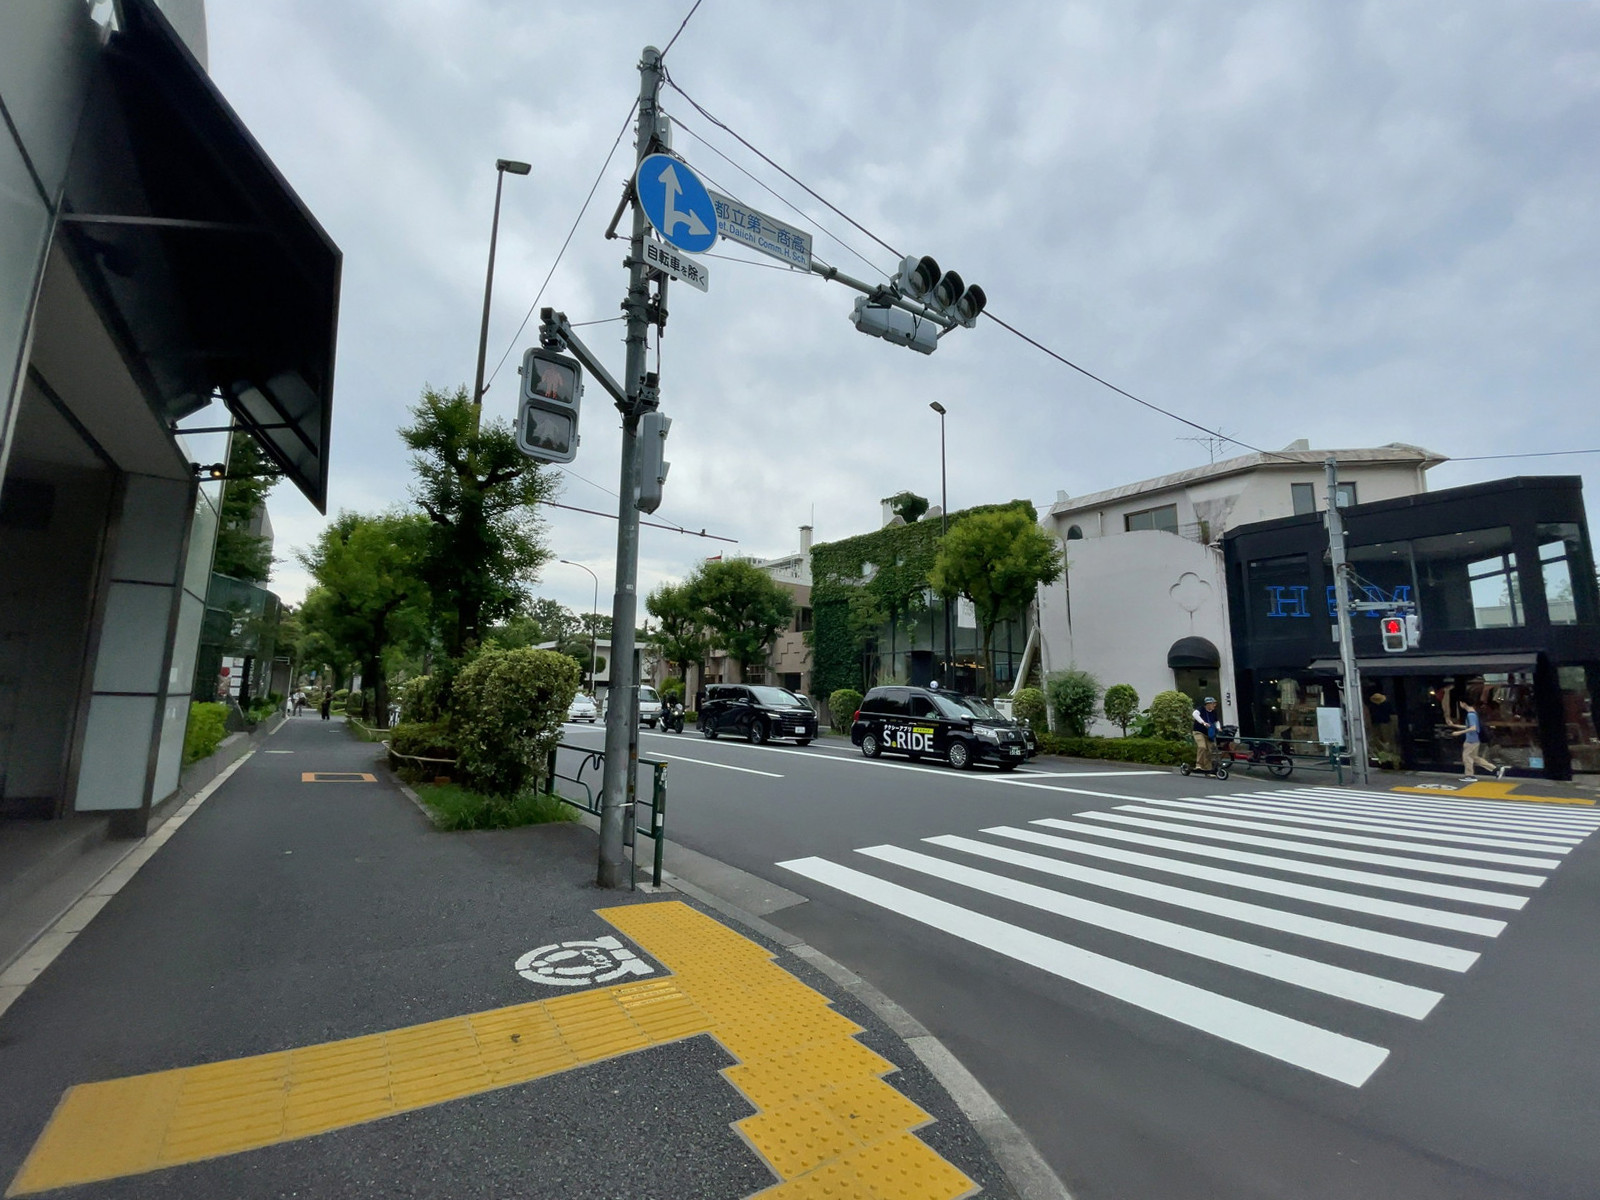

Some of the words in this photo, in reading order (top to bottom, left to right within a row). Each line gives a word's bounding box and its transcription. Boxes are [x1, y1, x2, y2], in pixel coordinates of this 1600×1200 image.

[715, 200, 805, 254] 都立第一商高
[718, 221, 728, 231] et.
[729, 224, 756, 243] Daiichi
[758, 237, 783, 255] Comm.
[784, 250, 792, 260] H.
[647, 244, 705, 286] 自転車を除く
[883, 730, 935, 752] S.RIDE
